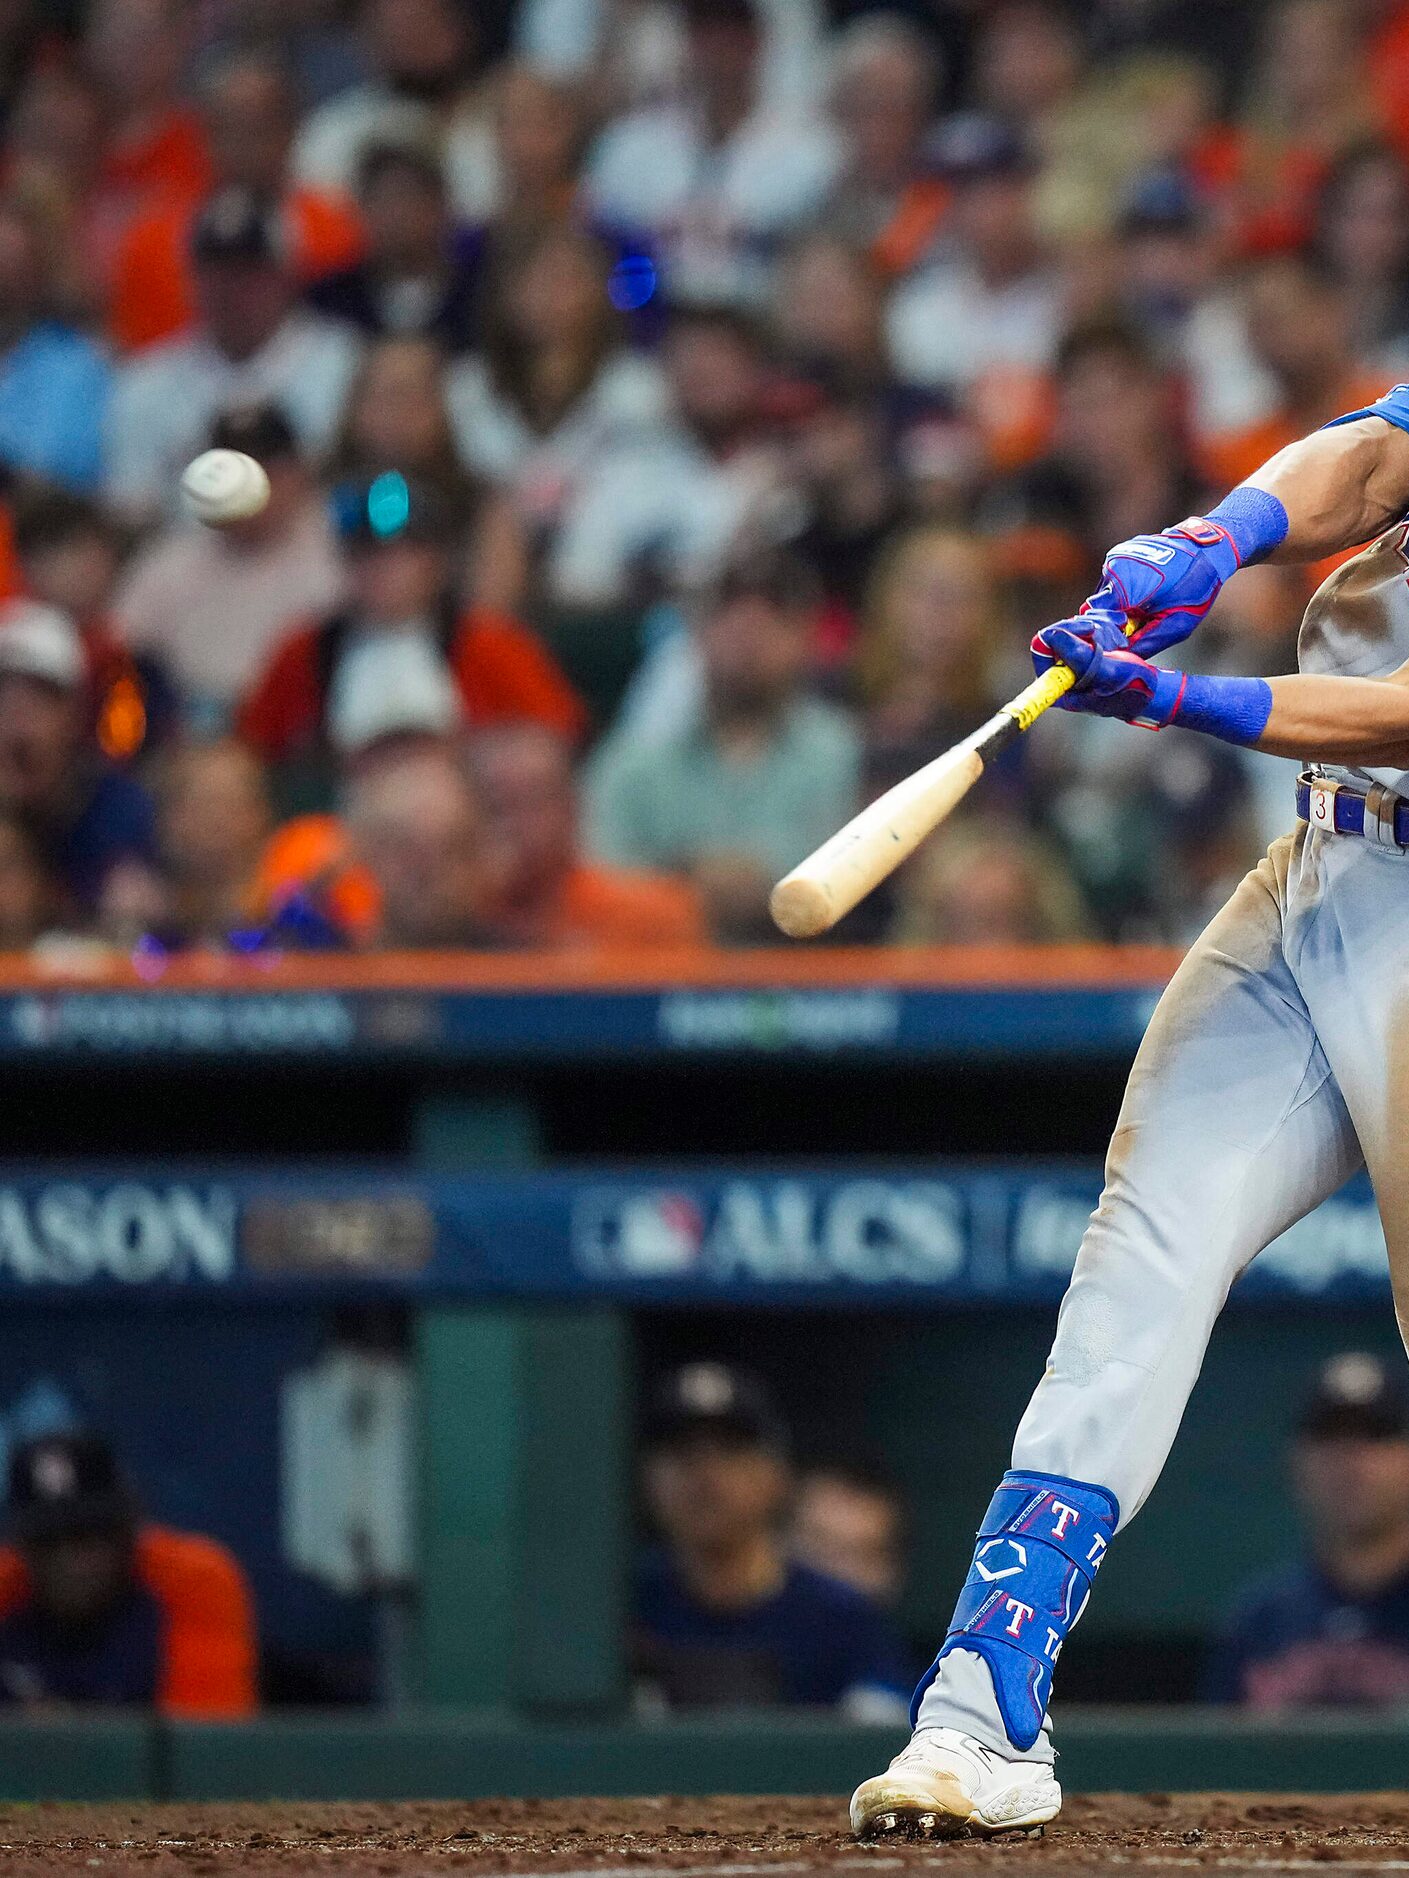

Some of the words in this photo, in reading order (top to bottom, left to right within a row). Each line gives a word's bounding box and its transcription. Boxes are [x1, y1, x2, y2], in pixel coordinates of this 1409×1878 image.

[1315, 792, 1327, 820] 3
[704, 1180, 965, 1284] ALCS
[1051, 1500, 1081, 1542] T
[1005, 1598, 1035, 1639] T
